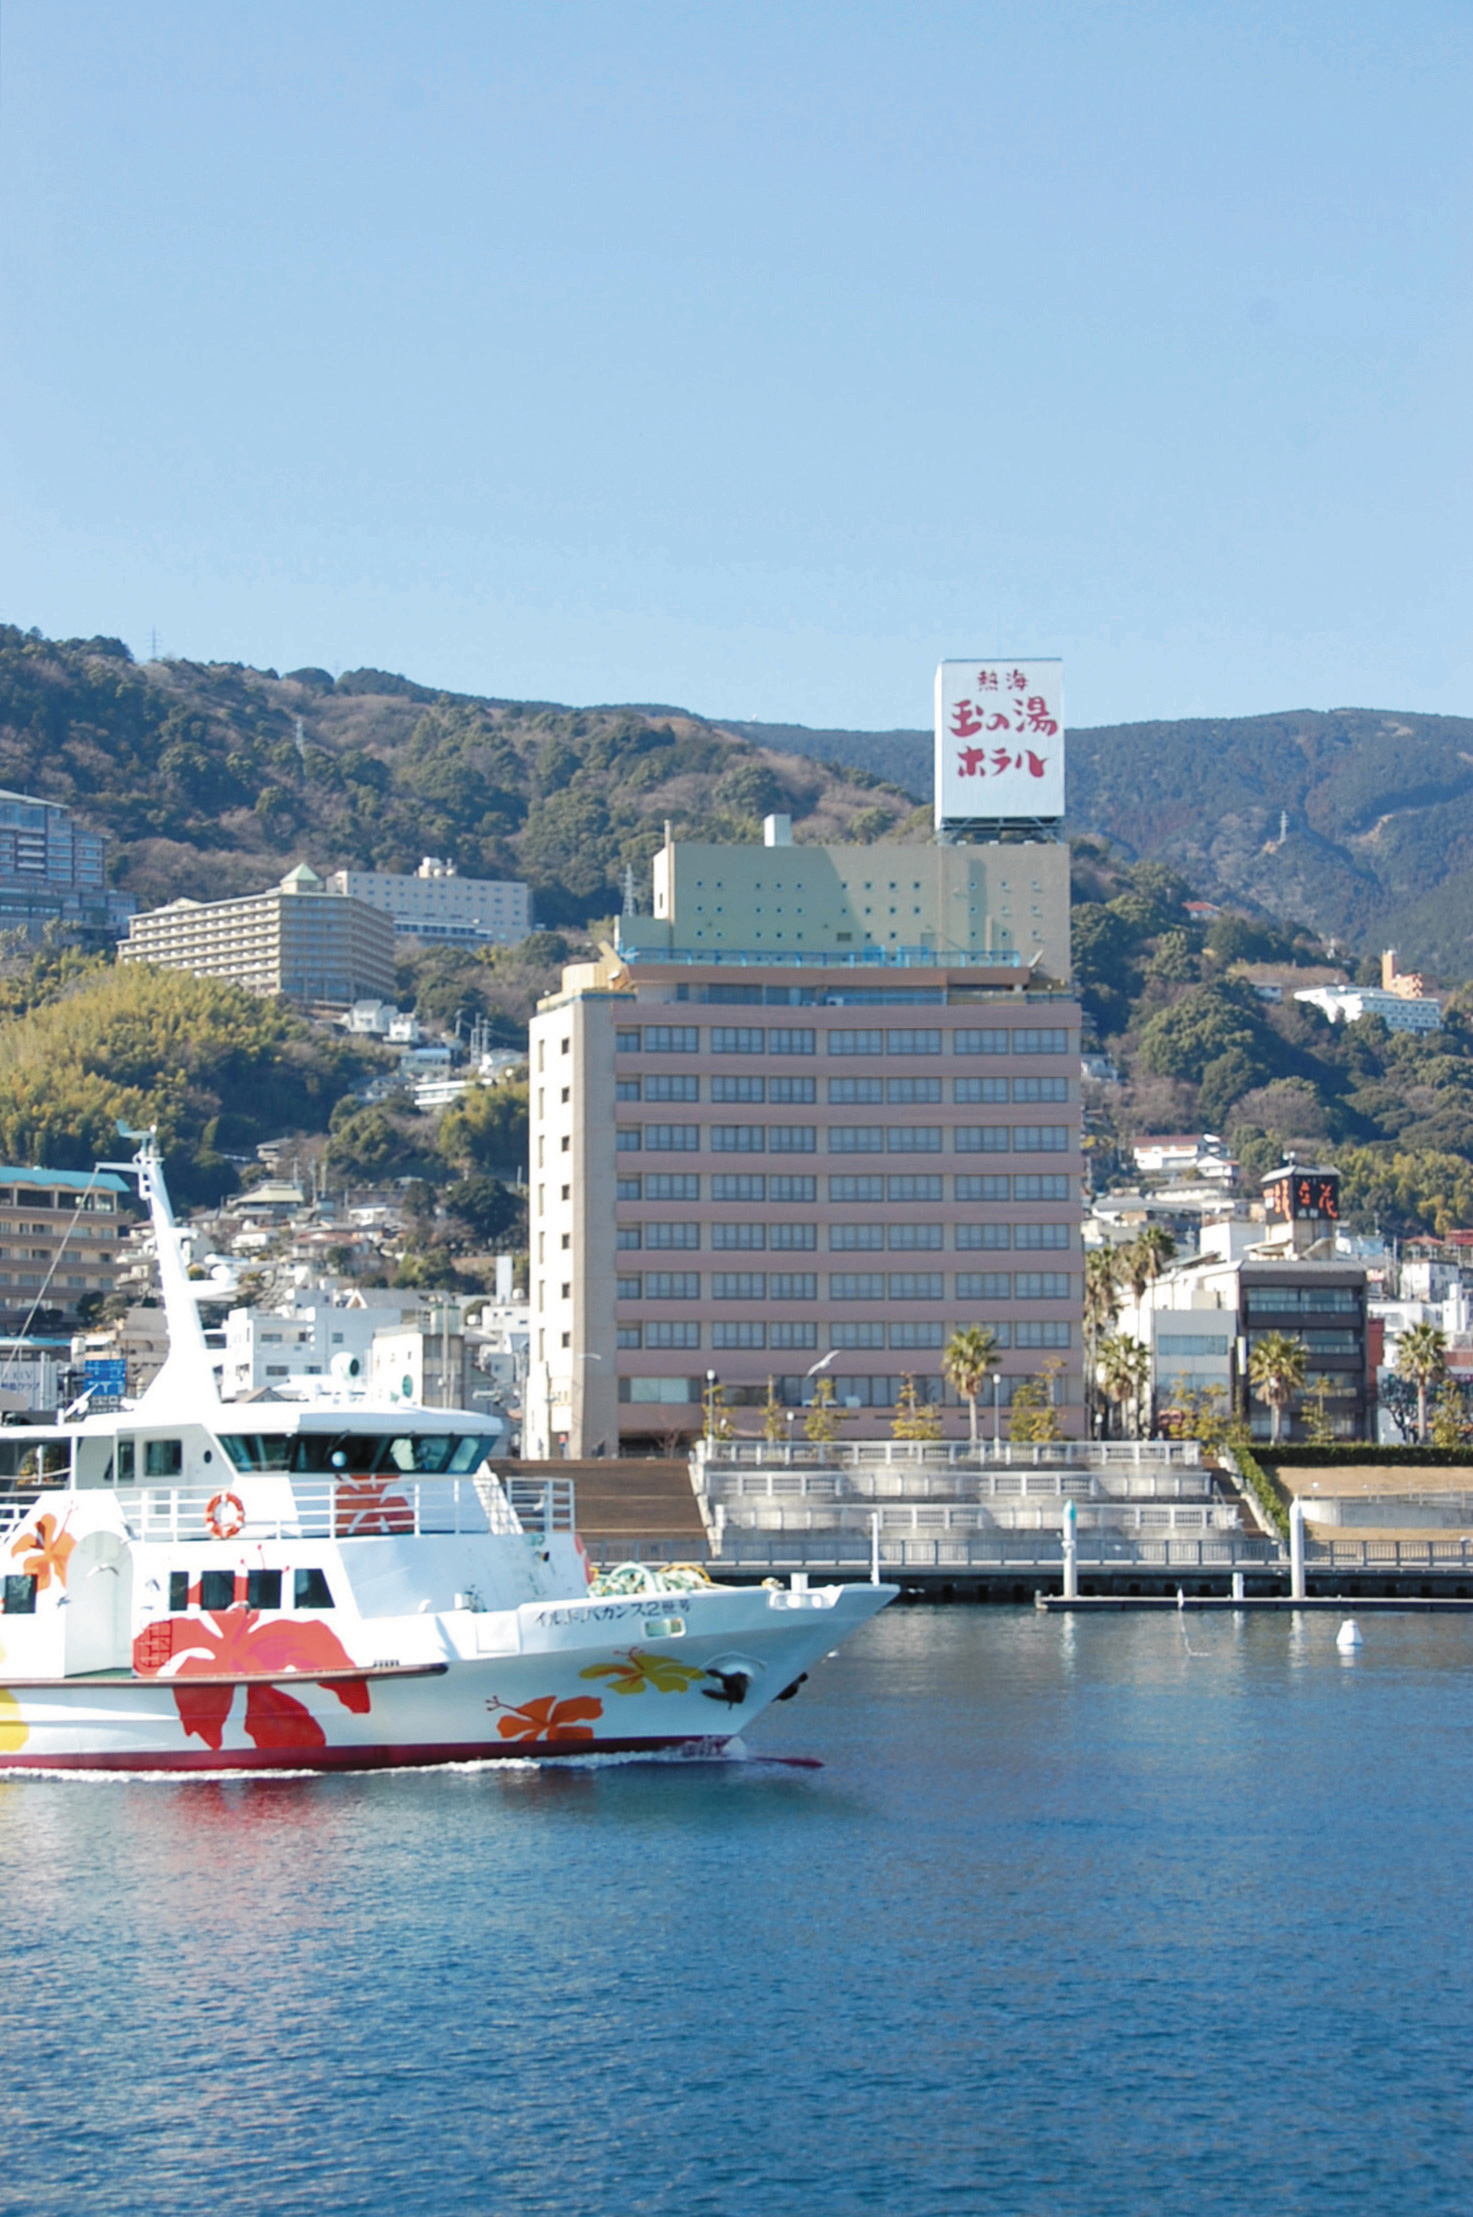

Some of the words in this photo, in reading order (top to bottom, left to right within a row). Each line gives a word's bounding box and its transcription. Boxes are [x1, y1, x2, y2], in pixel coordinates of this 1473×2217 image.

[977, 669, 1029, 691] 熱海
[949, 696, 1058, 737] 玉の湯
[957, 746, 1048, 778] ホテル
